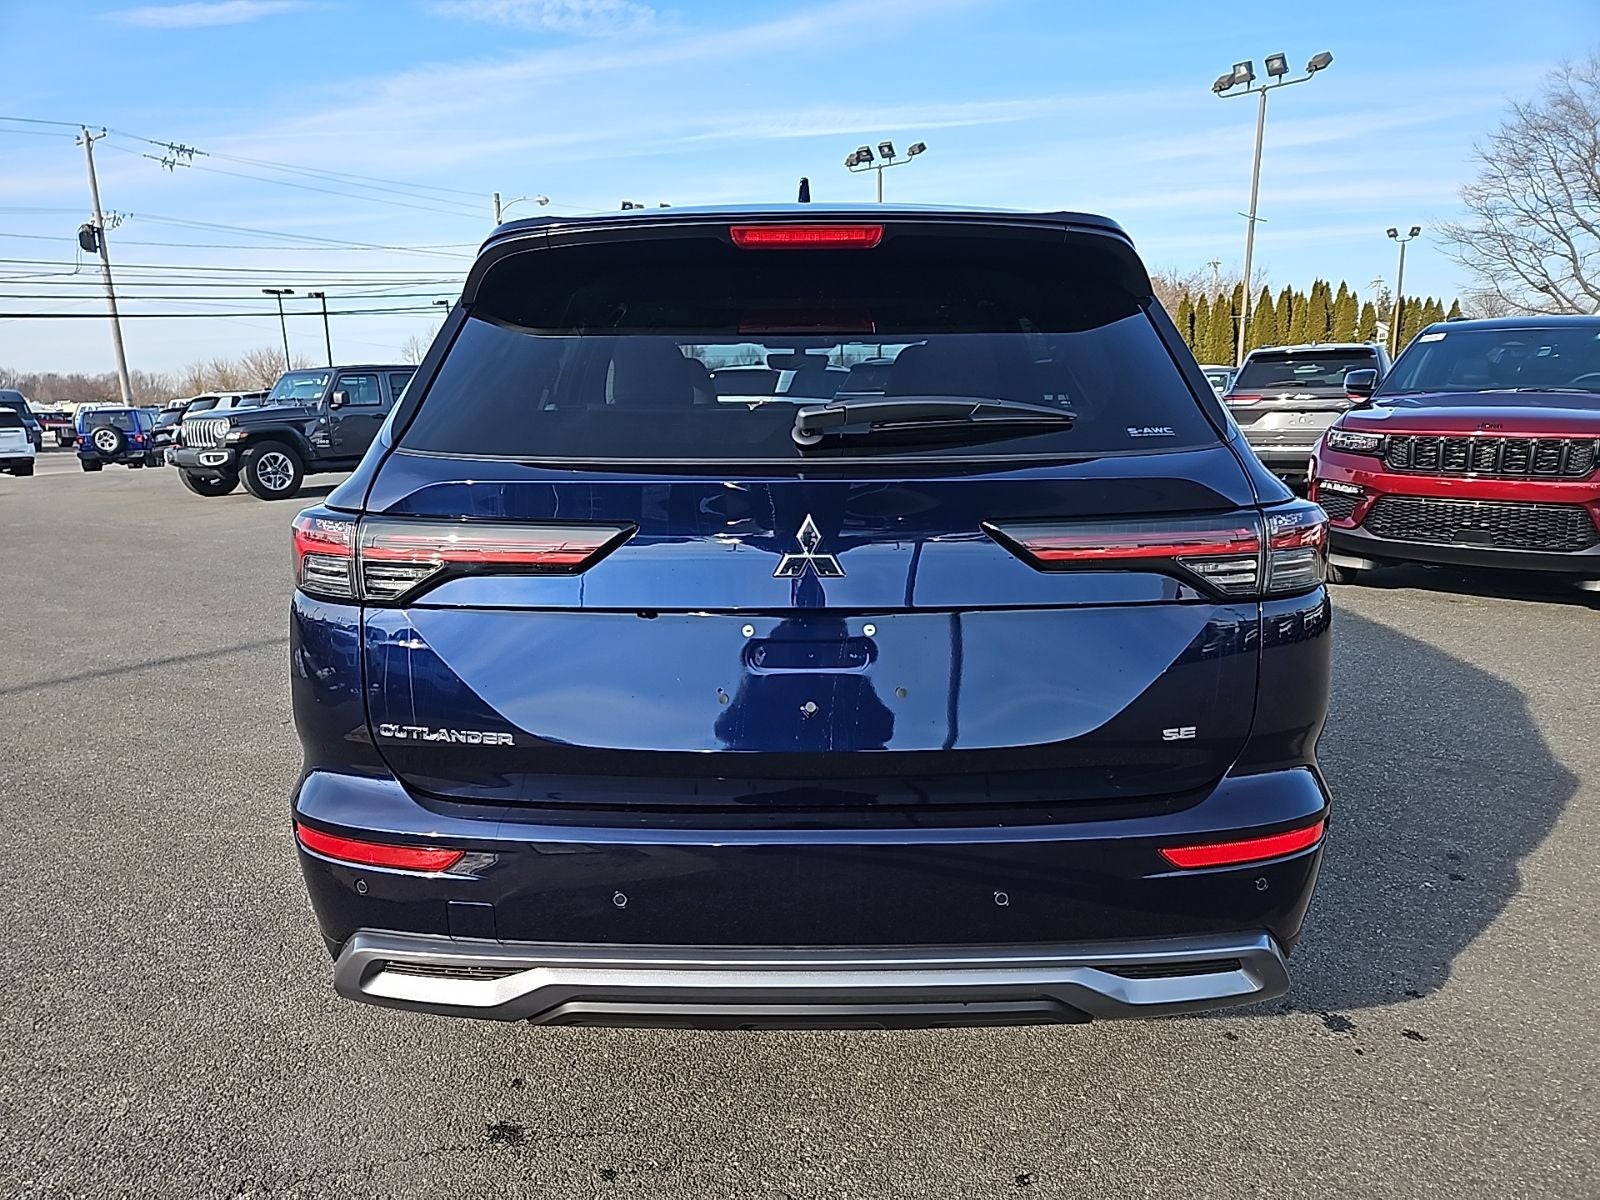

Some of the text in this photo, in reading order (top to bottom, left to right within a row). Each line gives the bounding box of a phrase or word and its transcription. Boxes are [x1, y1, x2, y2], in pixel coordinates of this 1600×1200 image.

[1127, 426, 1174, 435] S-AWC
[379, 723, 515, 746] OUTLANDER
[1162, 726, 1197, 741] SE
